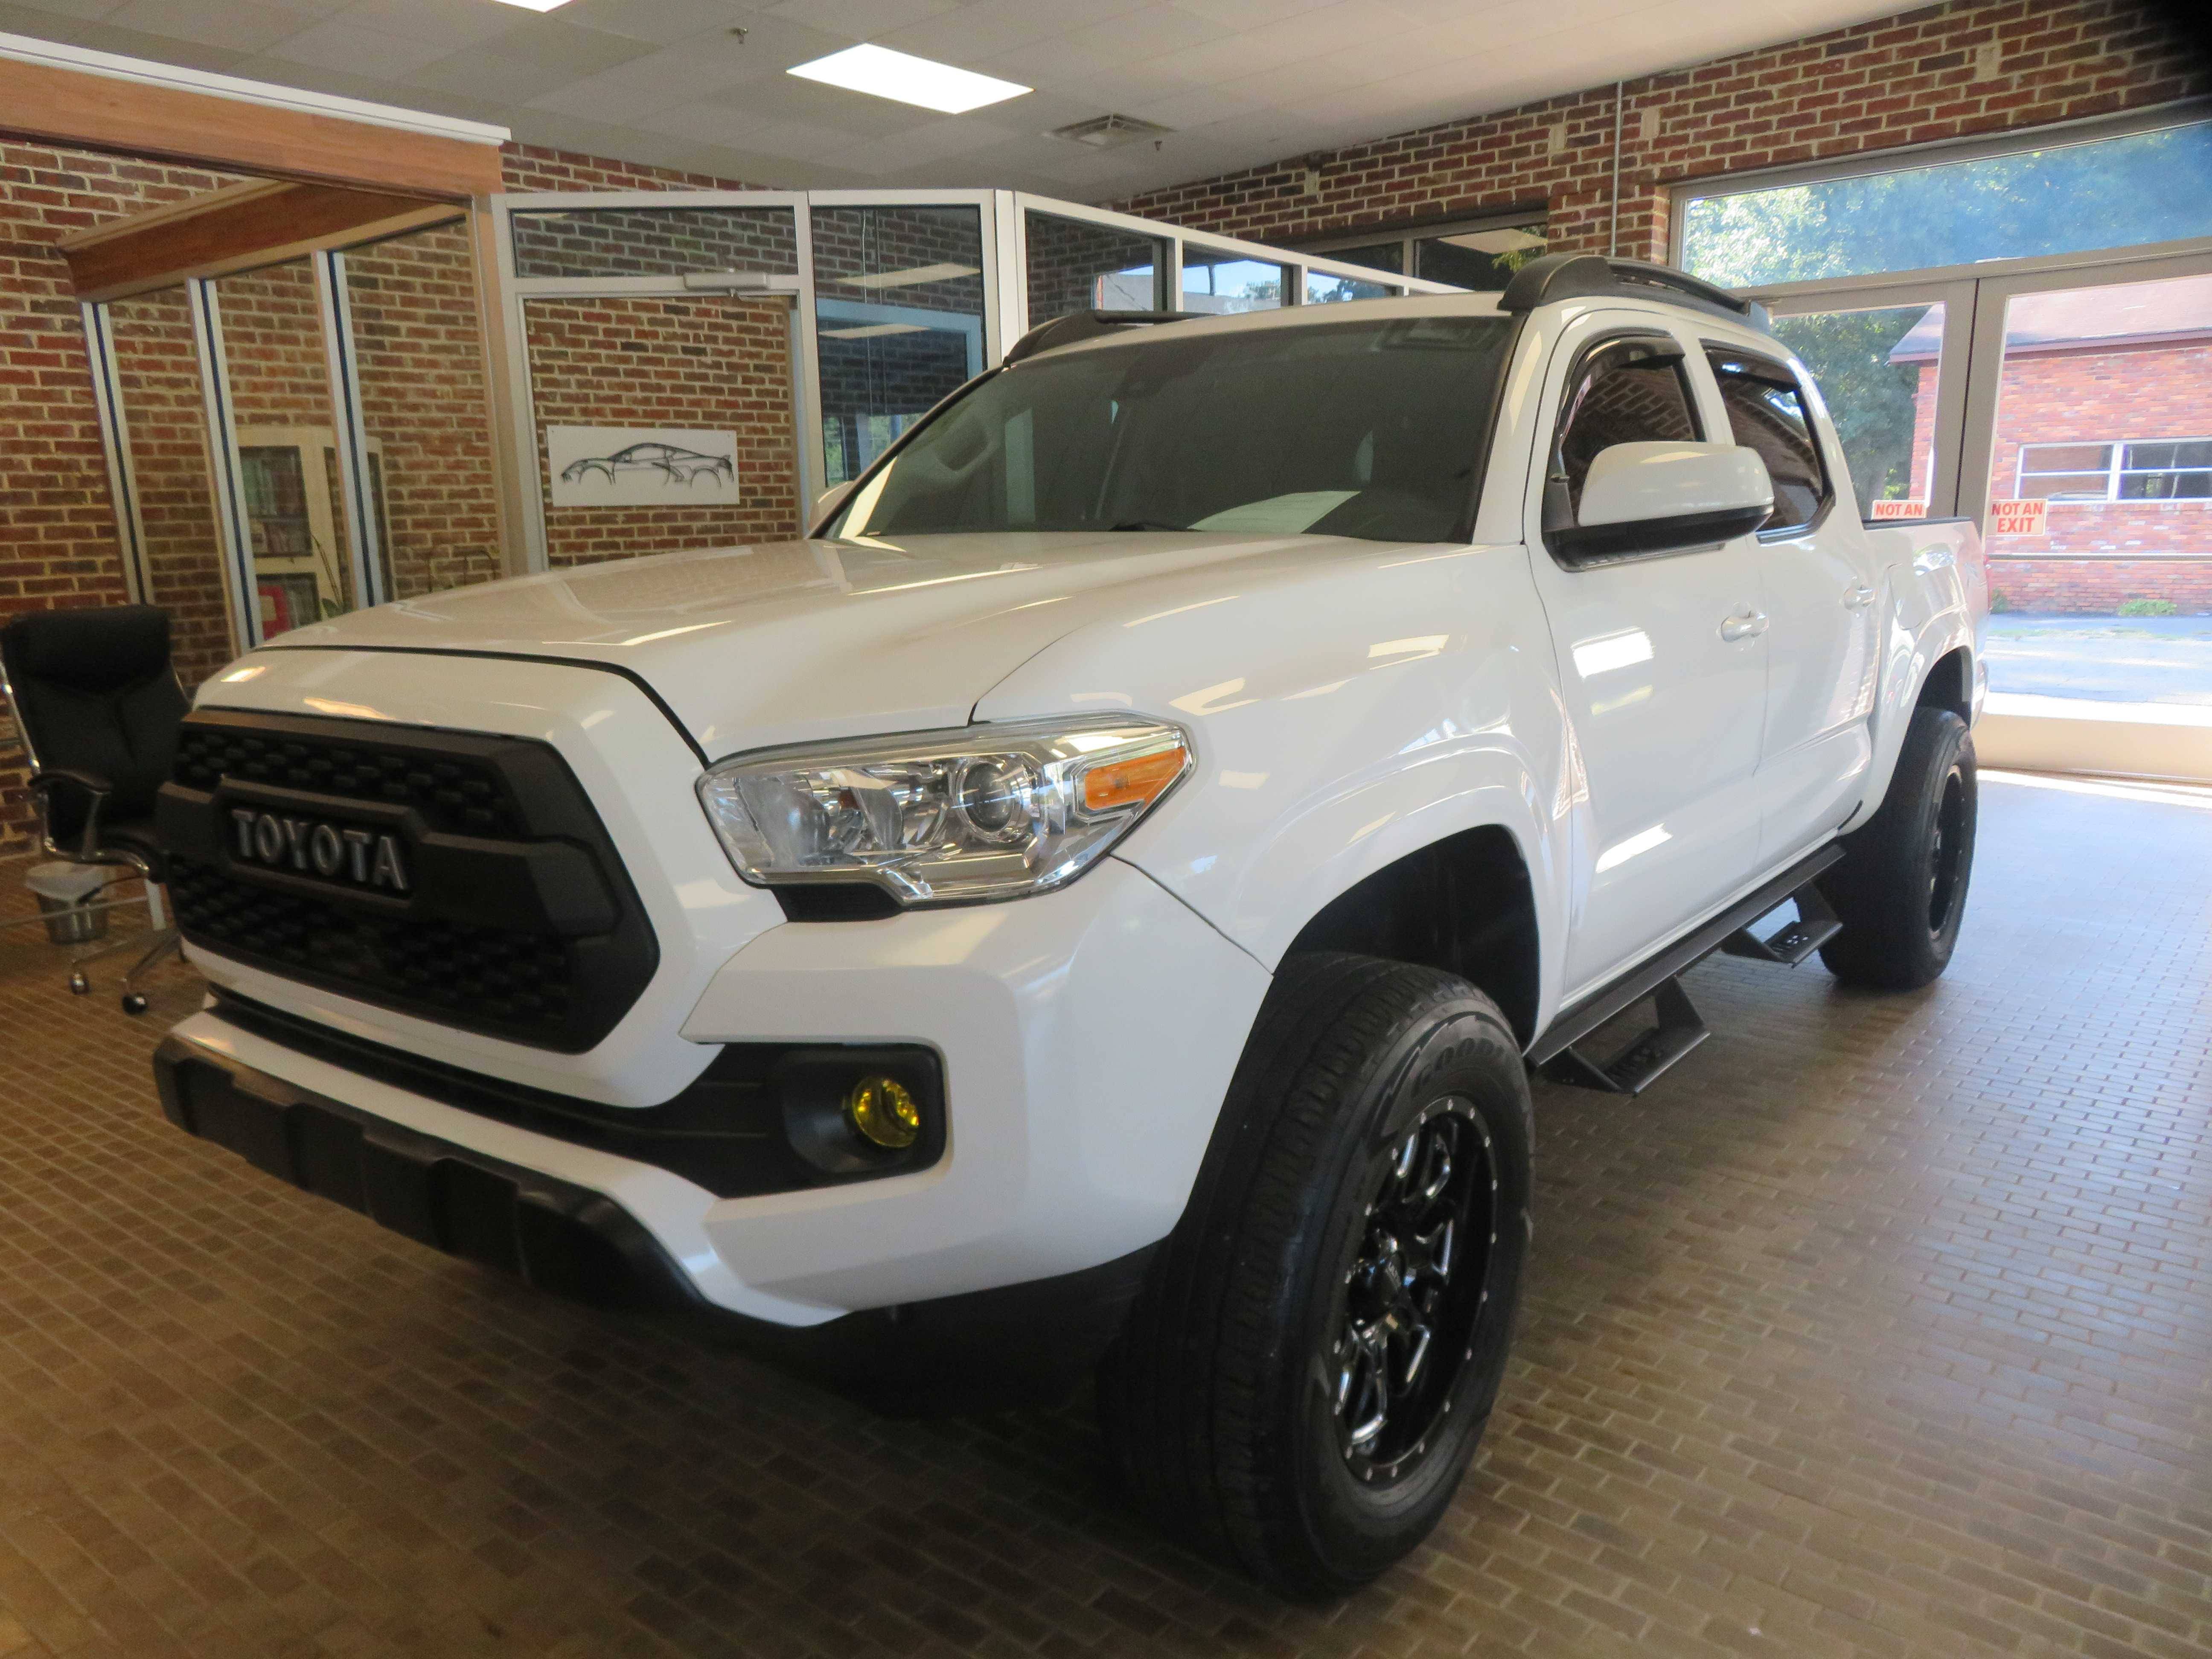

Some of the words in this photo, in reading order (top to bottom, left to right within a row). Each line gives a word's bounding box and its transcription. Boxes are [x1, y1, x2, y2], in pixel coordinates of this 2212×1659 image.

[1876, 504, 1902, 515] NOT
[1904, 504, 1923, 515] AN
[1992, 503, 2020, 515] NOT
[2024, 502, 2043, 515] AN
[1997, 518, 2035, 533] EXIT
[231, 809, 407, 891] TOYOTA
